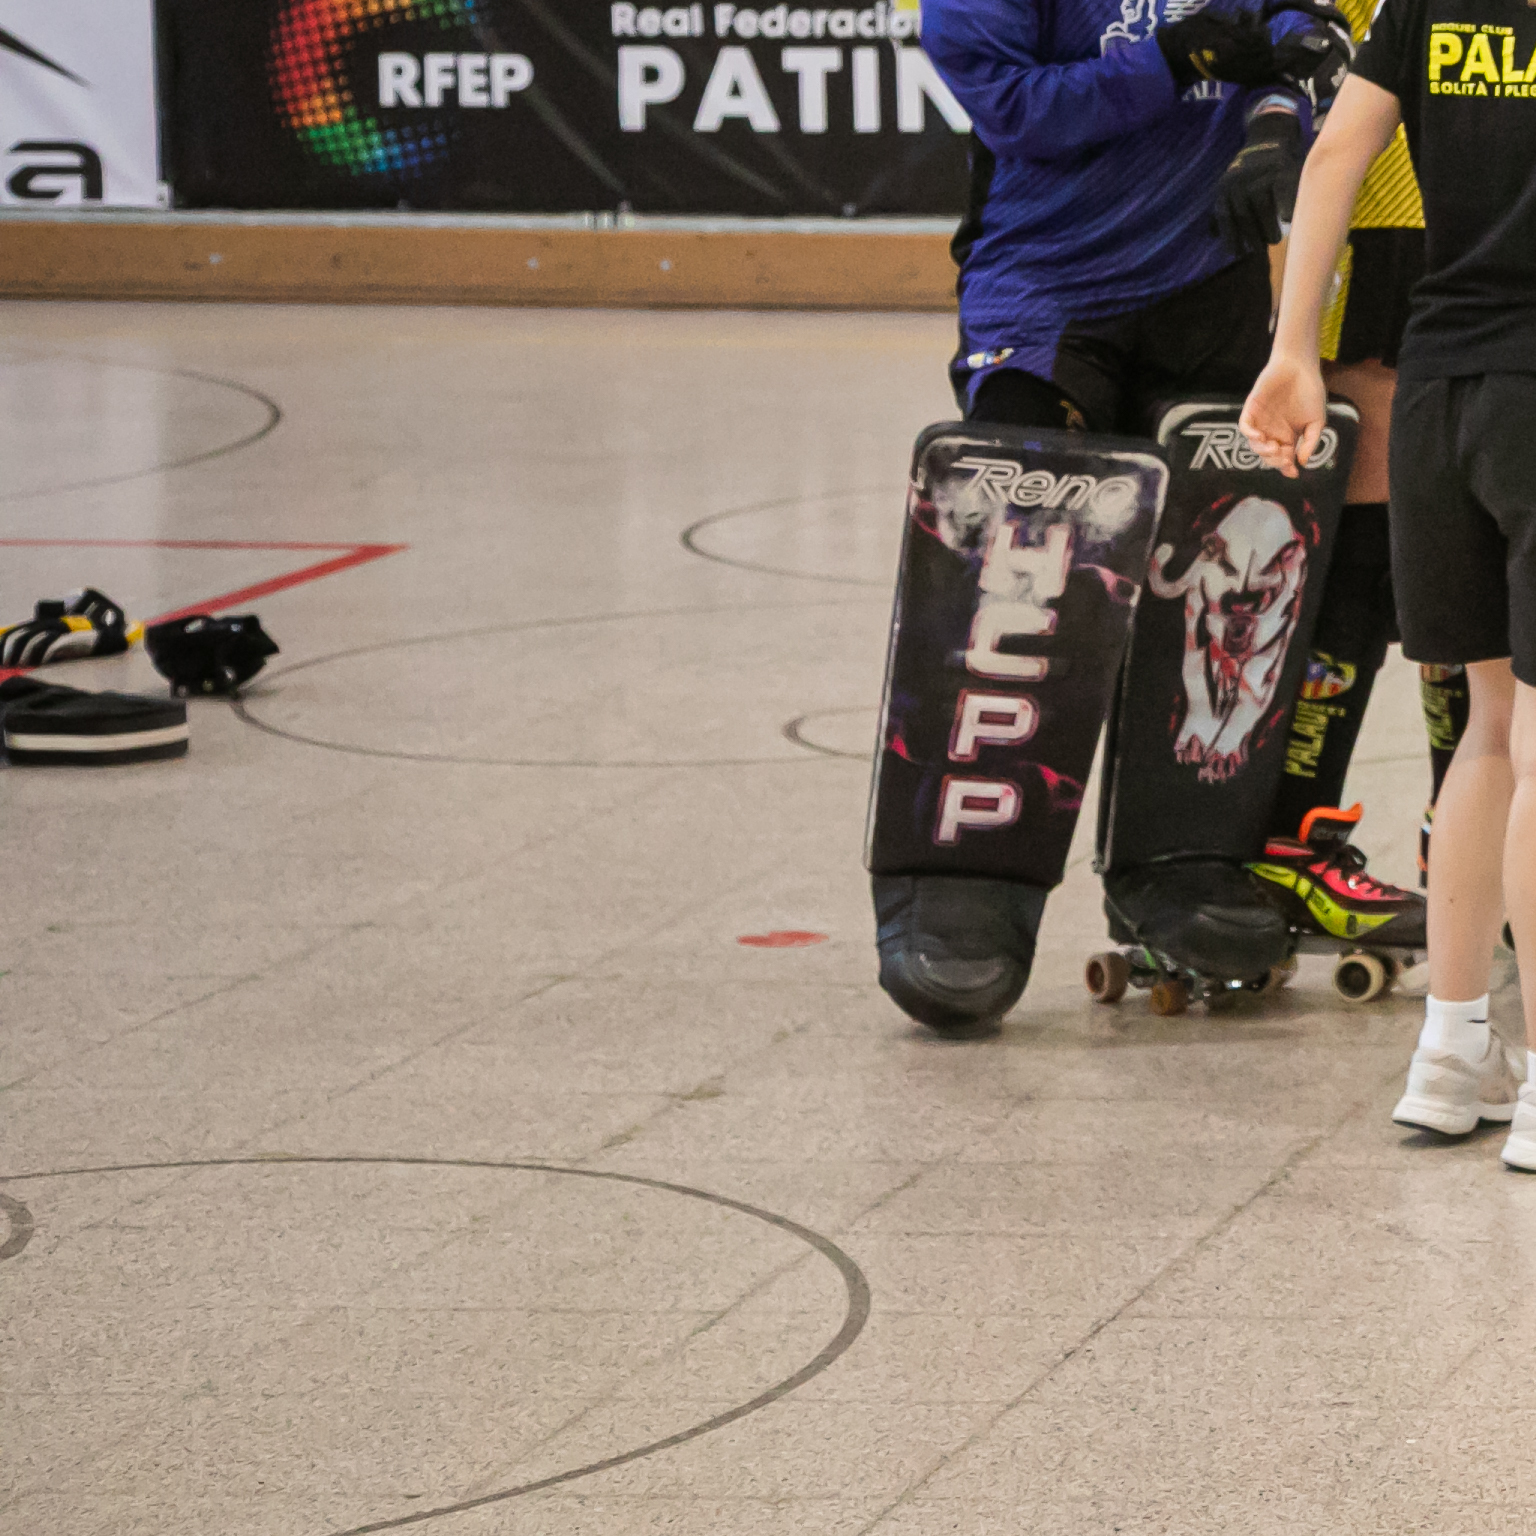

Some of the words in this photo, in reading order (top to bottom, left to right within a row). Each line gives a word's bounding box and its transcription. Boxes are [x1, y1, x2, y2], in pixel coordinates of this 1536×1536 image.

[611, 1, 704, 37] Real
[378, 52, 534, 109] RFEP
[951, 456, 1140, 511] Reno
